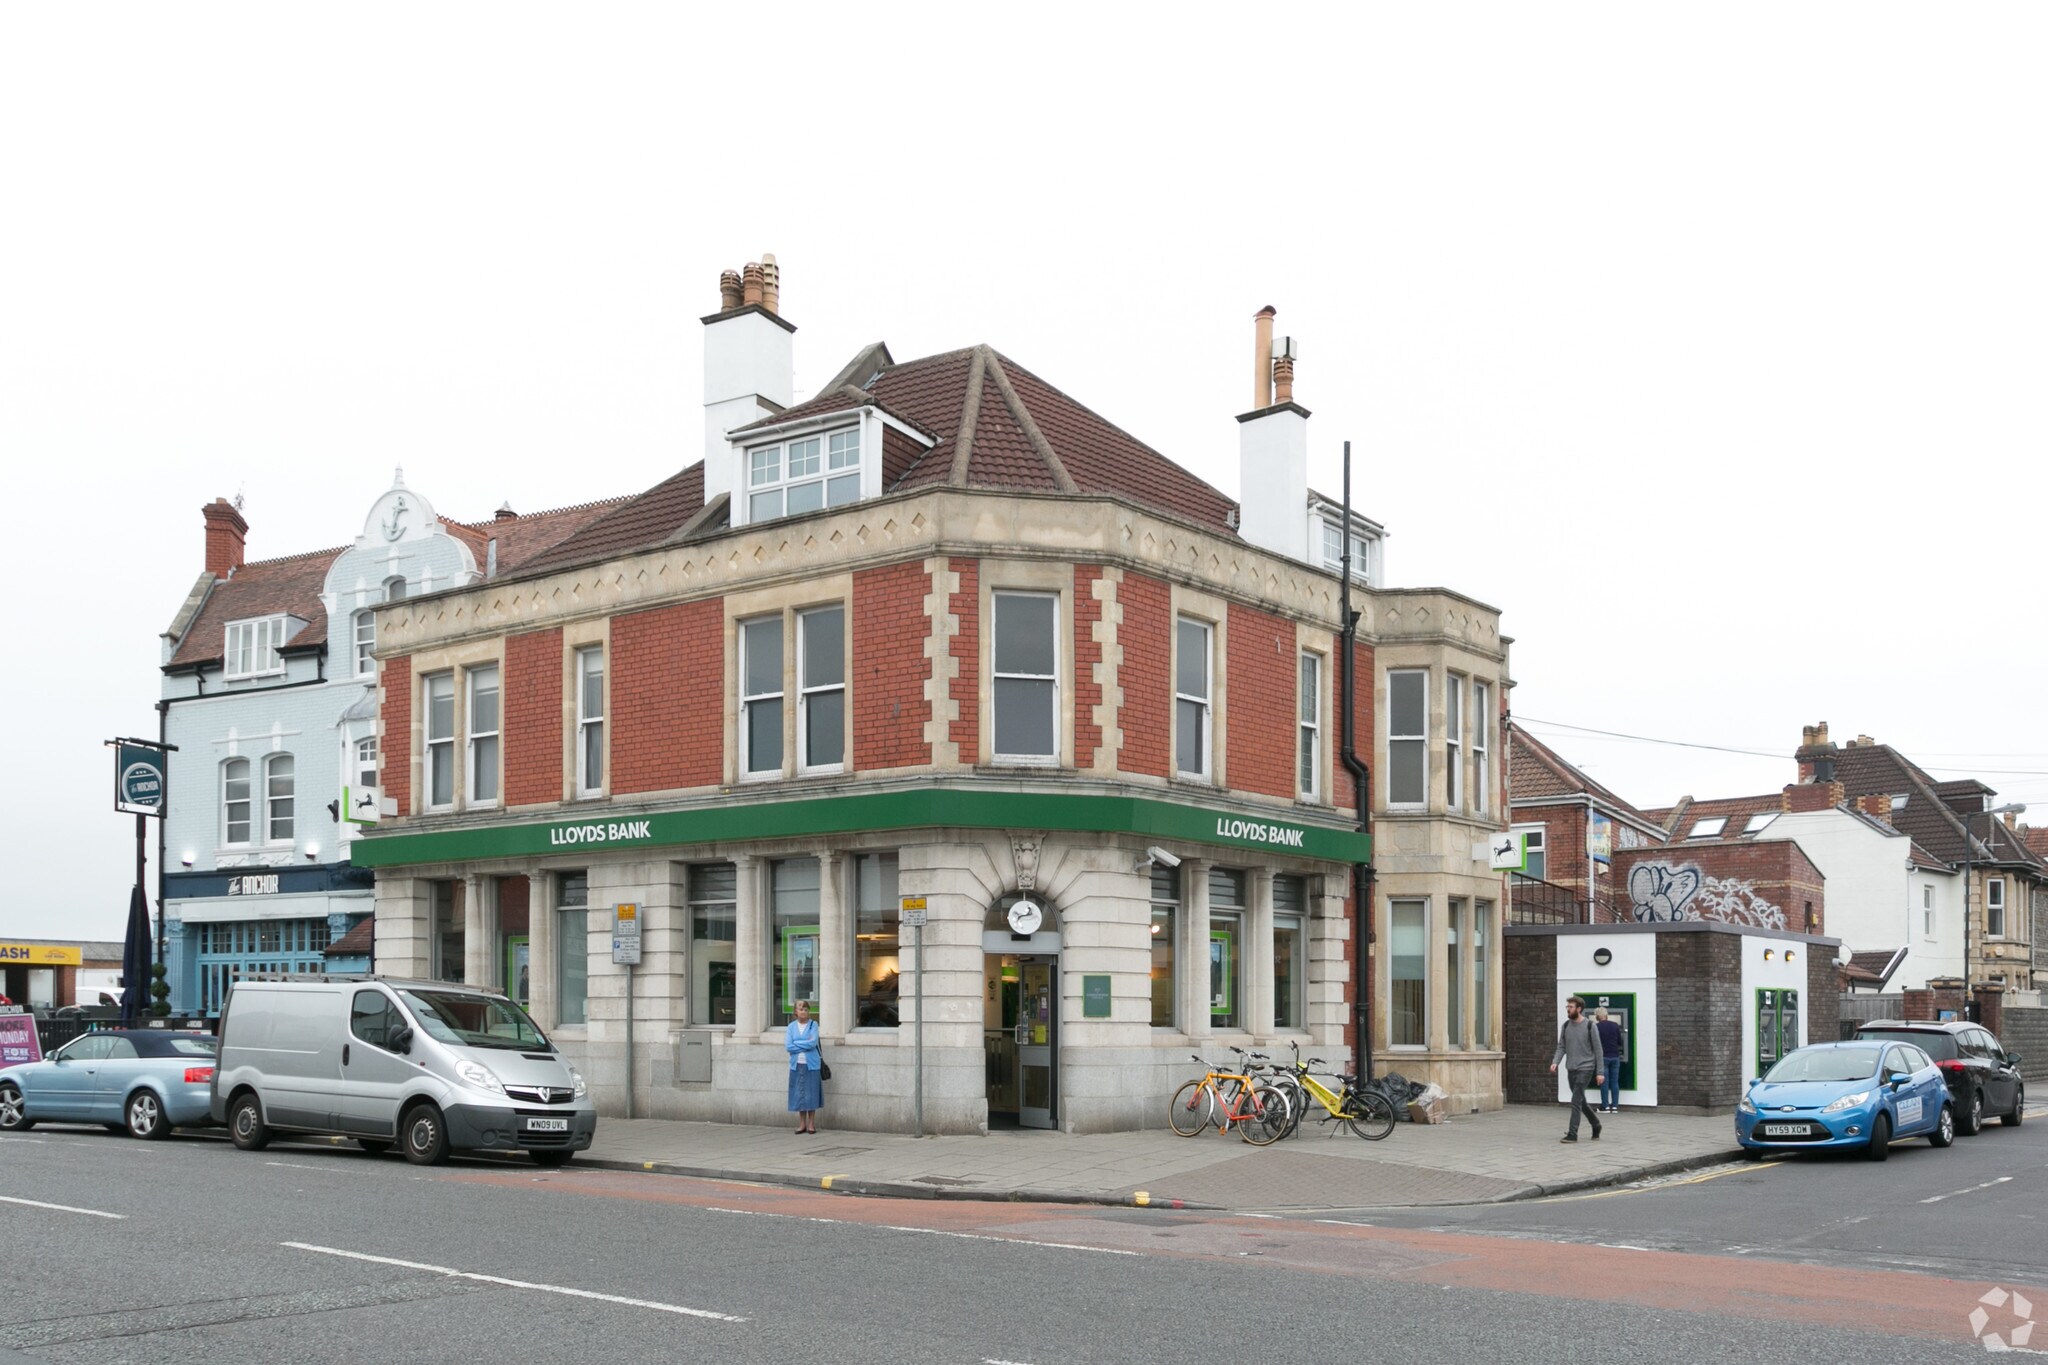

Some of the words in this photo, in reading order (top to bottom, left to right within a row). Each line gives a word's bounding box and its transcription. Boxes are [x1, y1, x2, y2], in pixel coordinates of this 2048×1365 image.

[551, 824, 606, 845] LLOYDS
[608, 820, 651, 840] BANK
[1216, 818, 1267, 842] LLOYDS
[1268, 826, 1304, 847] BANK
[242, 875, 279, 895] ANCHOR
[1768, 1126, 1790, 1134] HY59
